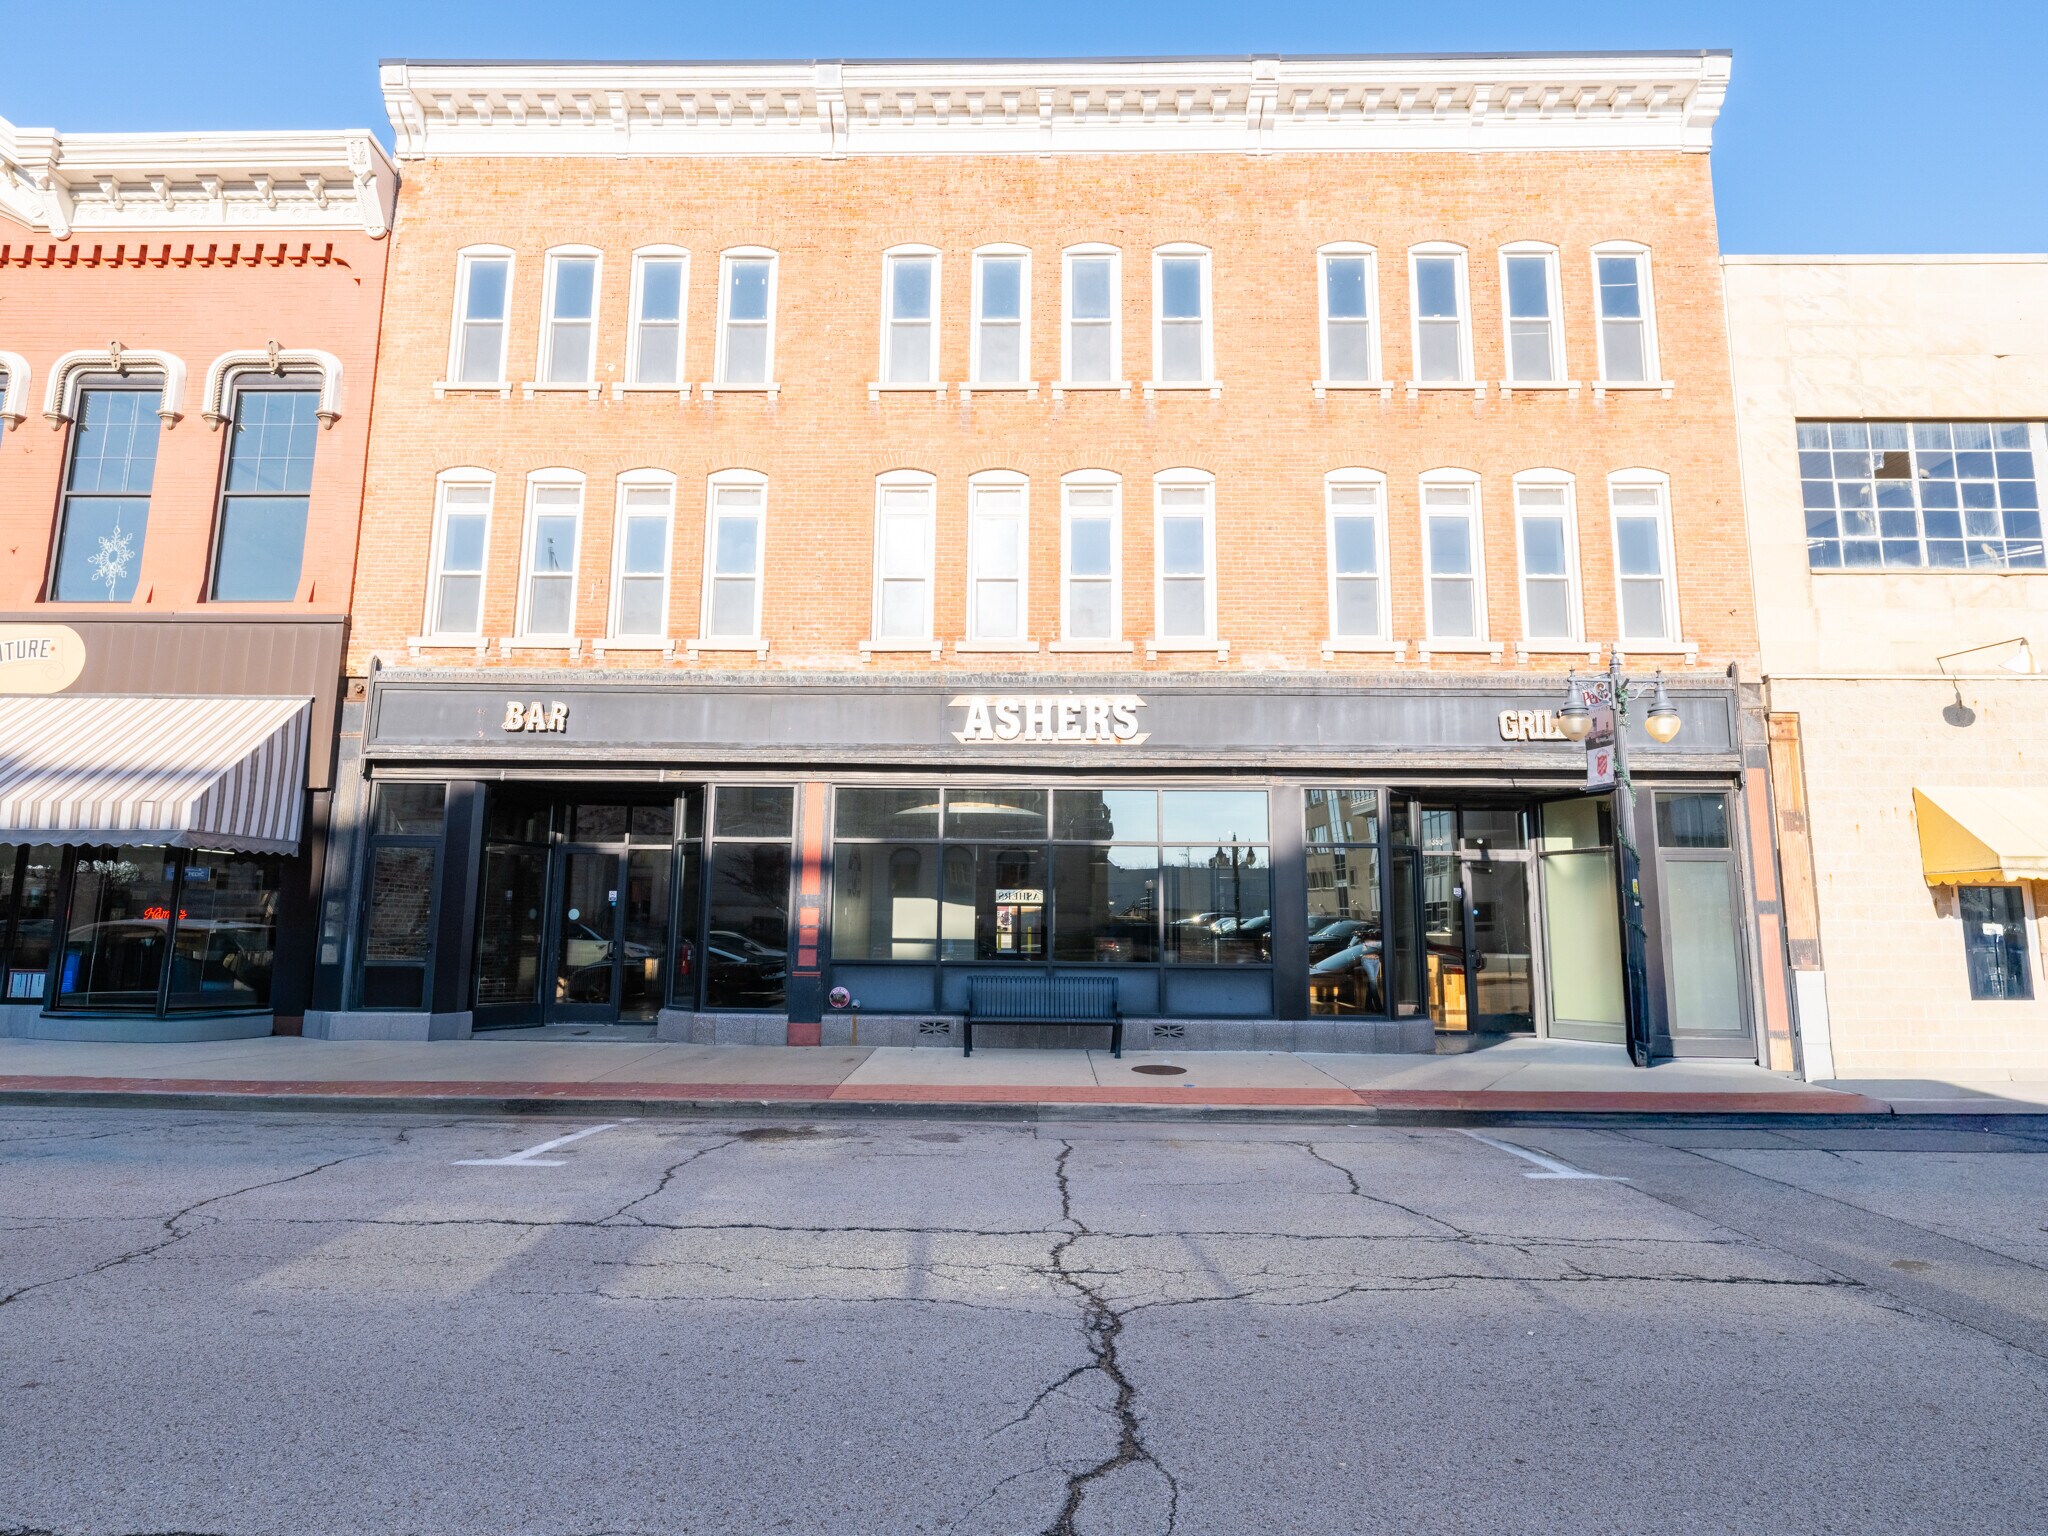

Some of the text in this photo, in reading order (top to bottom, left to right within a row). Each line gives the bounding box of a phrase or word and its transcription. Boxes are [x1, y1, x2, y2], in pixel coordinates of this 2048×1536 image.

[501, 701, 568, 732] BAR
[963, 696, 1139, 741] ASHERS
[1499, 709, 1570, 741] GRIL
